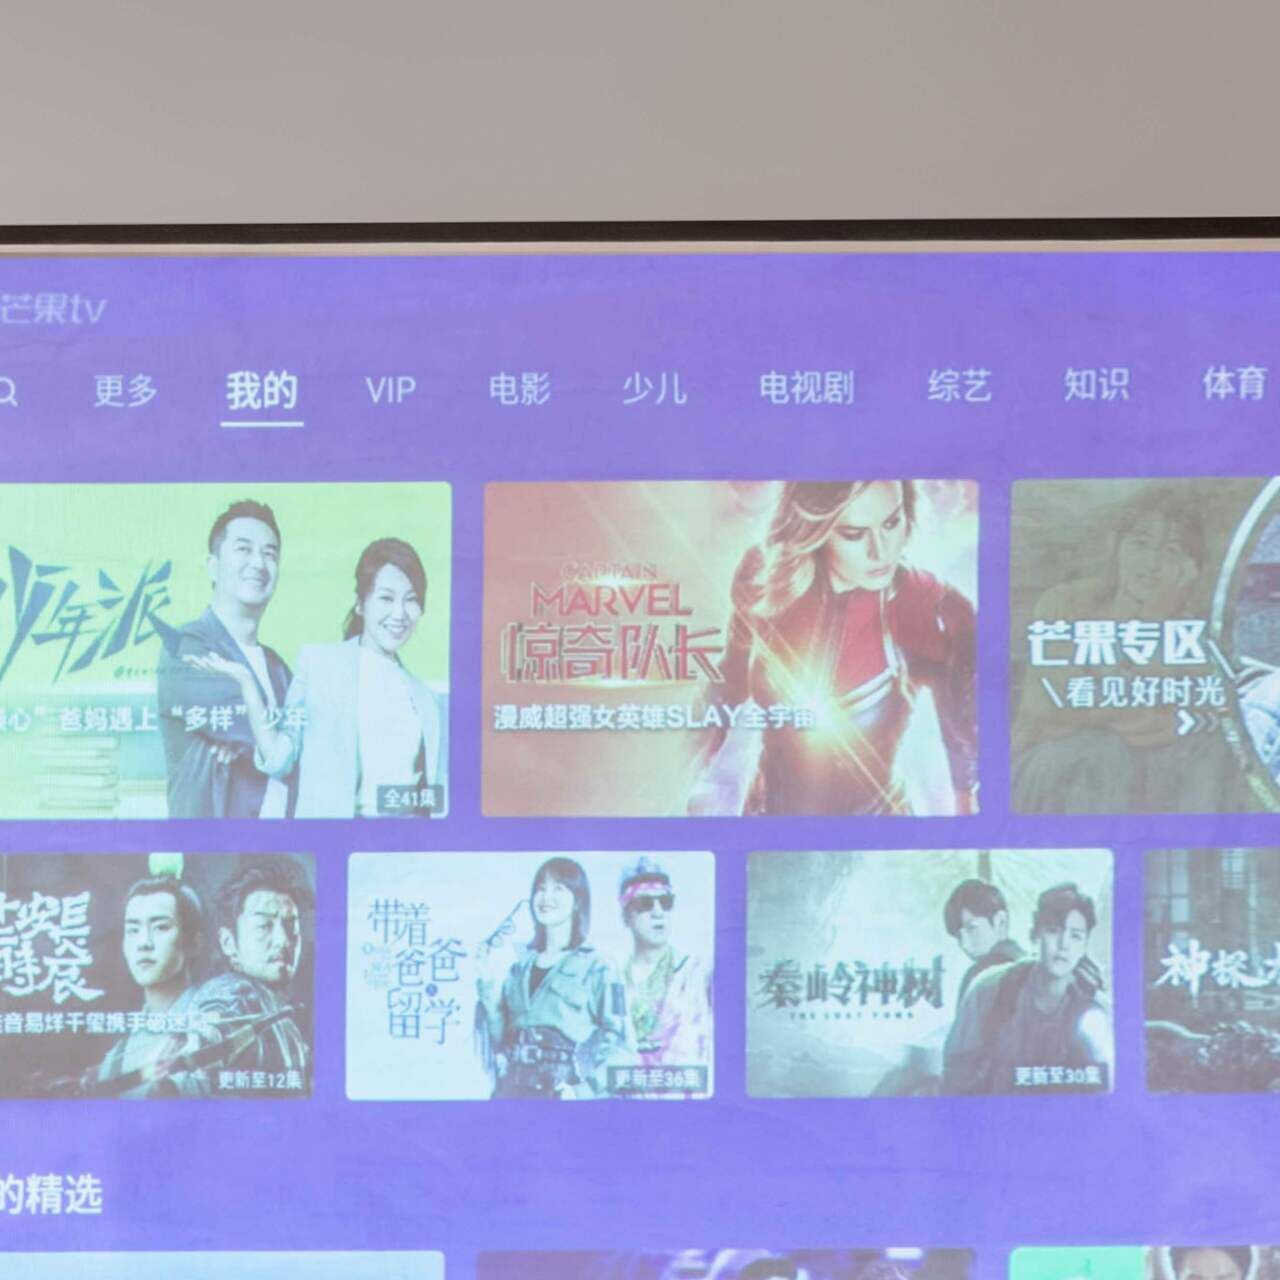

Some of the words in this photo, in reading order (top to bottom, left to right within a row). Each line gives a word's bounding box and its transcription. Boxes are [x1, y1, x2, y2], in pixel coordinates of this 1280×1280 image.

[94, 374, 158, 407] 更多
[226, 370, 298, 410] 我的
[366, 375, 416, 404] VIP
[489, 371, 551, 406] 电影
[622, 371, 688, 405] 少儿
[759, 370, 855, 405] 电视剧
[927, 369, 993, 403] 综艺
[1064, 367, 1131, 402] 知识
[1203, 365, 1268, 401] 体育
[532, 581, 694, 618] MARVEL
[502, 621, 725, 683] 惊奇队长
[1027, 619, 1208, 666] 芒果专区
[1066, 676, 1225, 707] 看见好时光
[756, 954, 946, 1011] 秦岭神树
